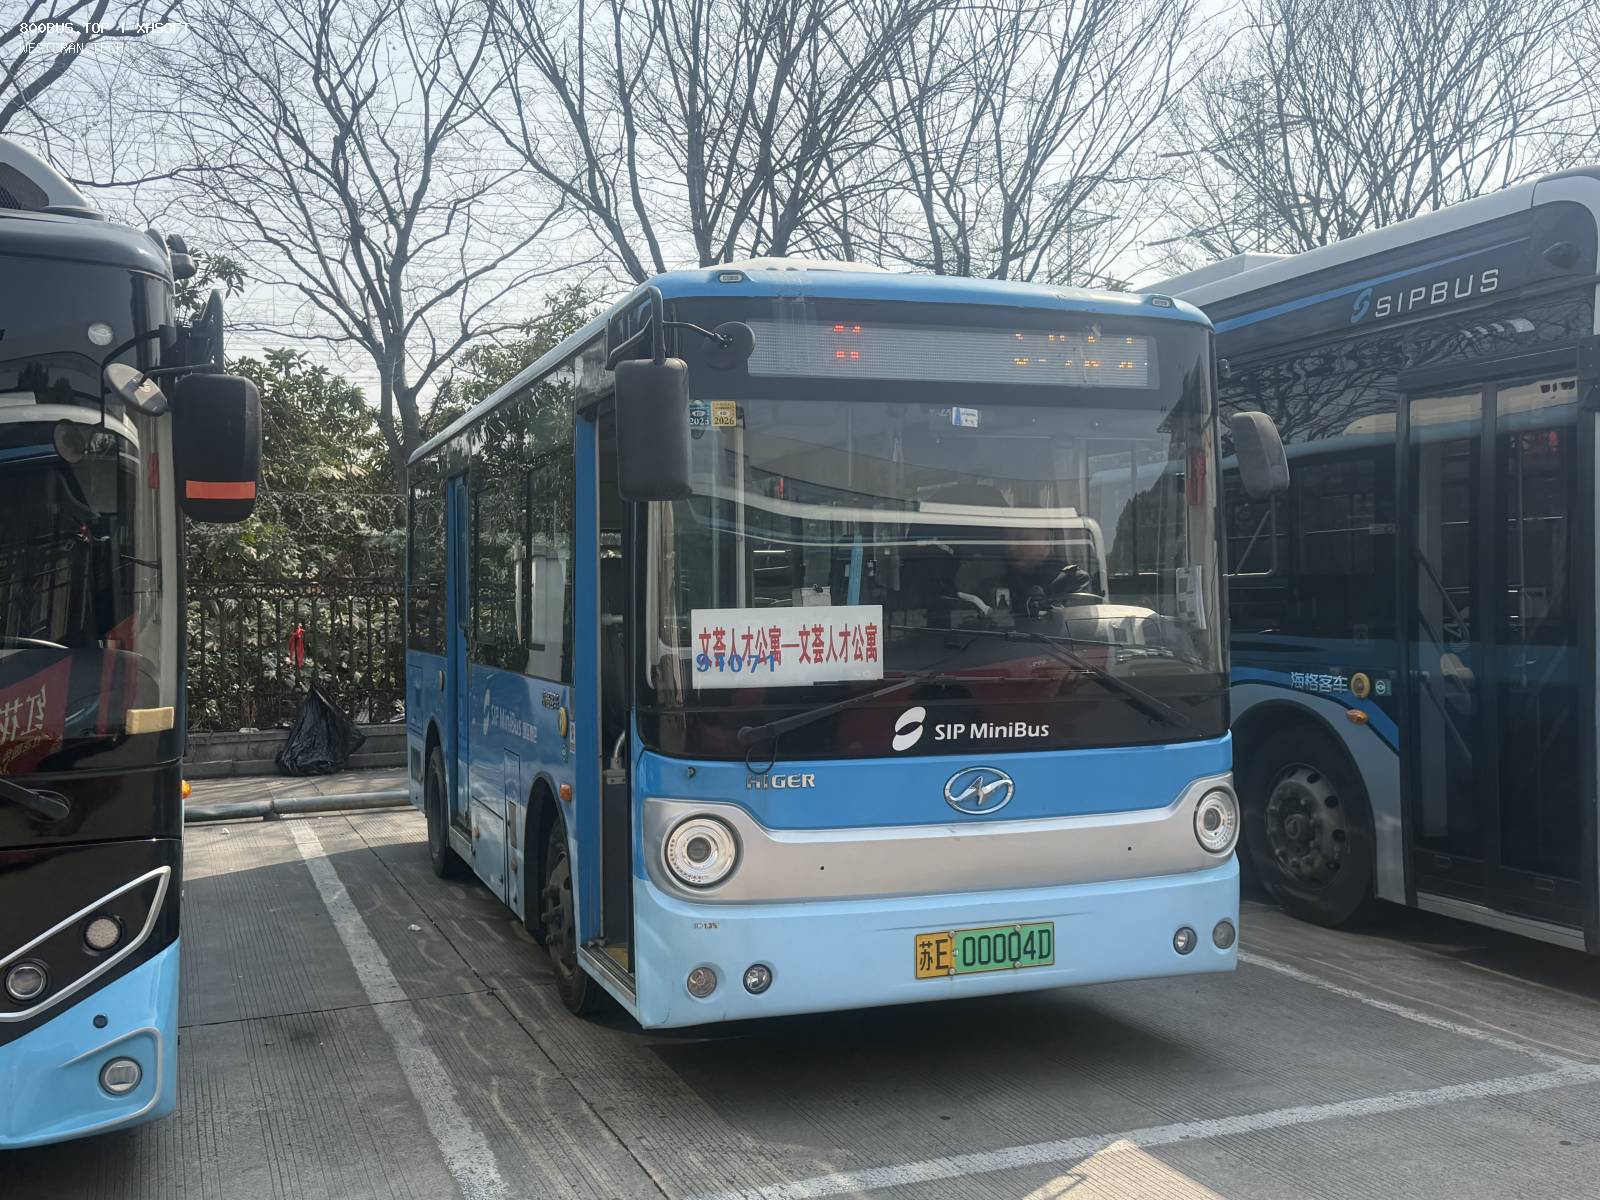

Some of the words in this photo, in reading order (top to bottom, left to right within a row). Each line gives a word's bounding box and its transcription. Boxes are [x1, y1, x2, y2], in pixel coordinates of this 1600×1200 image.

[1375, 268, 1500, 319] SIPBUS
[713, 416, 735, 425] 2026
[1290, 671, 1349, 693] 海格客车
[934, 723, 966, 741] SIP
[970, 721, 1050, 739] MiniBus
[746, 773, 816, 790] HIGER
